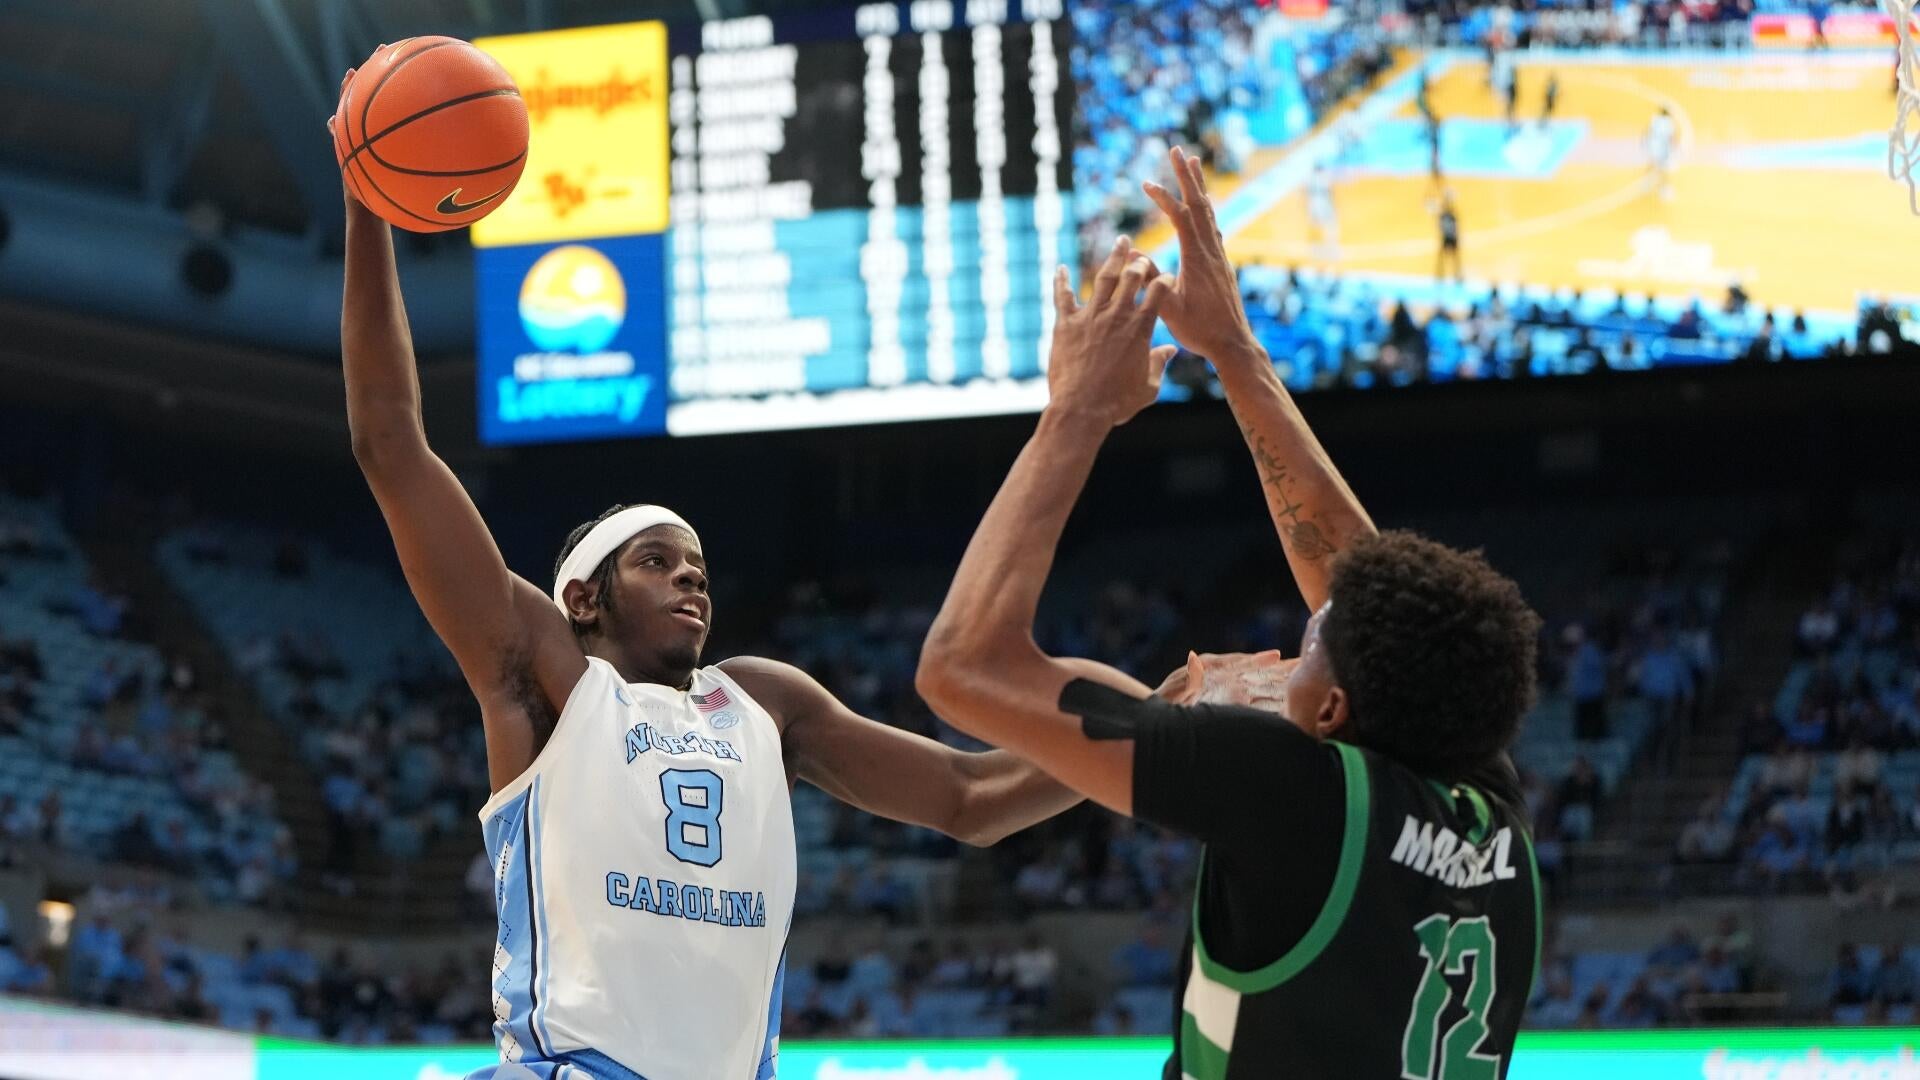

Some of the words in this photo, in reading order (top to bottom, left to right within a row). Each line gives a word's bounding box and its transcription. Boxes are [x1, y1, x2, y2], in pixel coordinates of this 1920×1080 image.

[625, 722, 743, 764] NORTH
[659, 767, 724, 868] 8
[605, 871, 766, 928] CAROLINA
[1400, 912, 1501, 1080] 12
